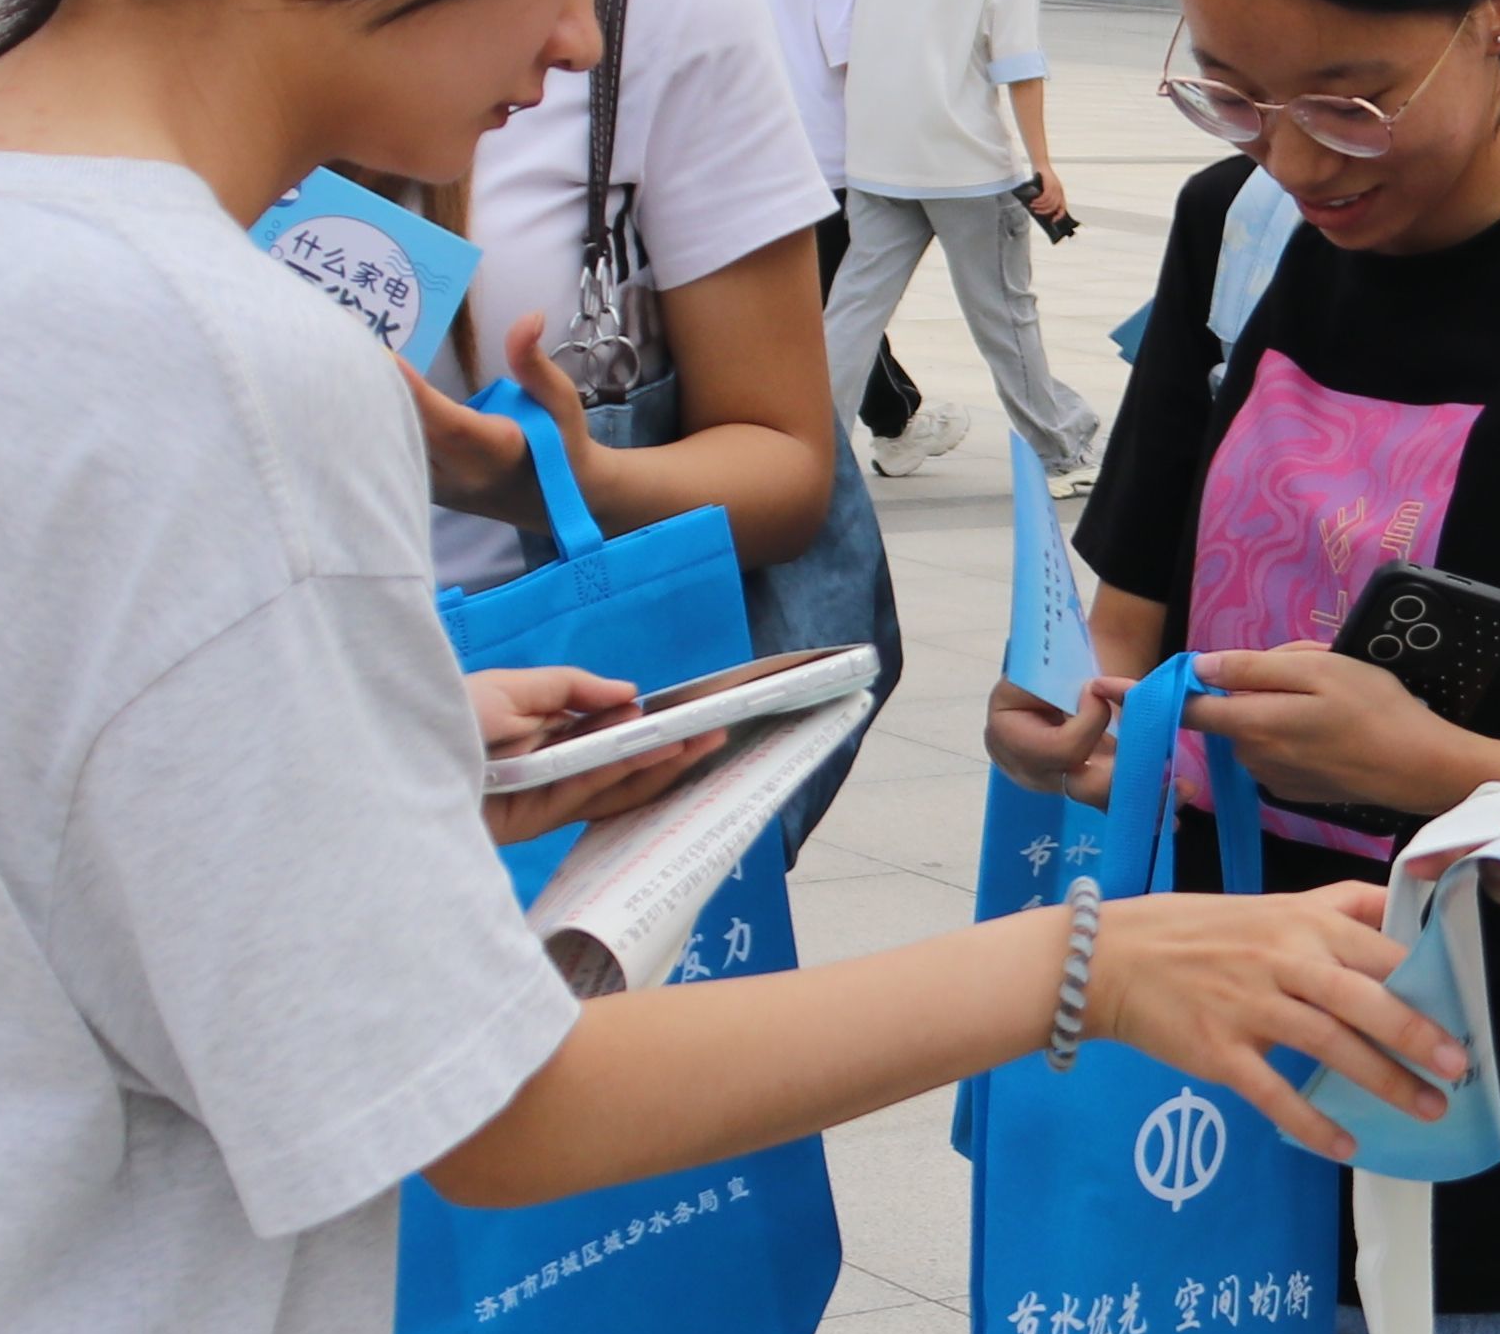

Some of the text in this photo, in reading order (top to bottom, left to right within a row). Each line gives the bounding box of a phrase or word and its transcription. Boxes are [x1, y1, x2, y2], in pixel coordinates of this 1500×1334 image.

[292, 230, 409, 308] 什么家电
[1019, 834, 1102, 877] 节水
[1175, 1270, 1313, 1332] 空间均衡
